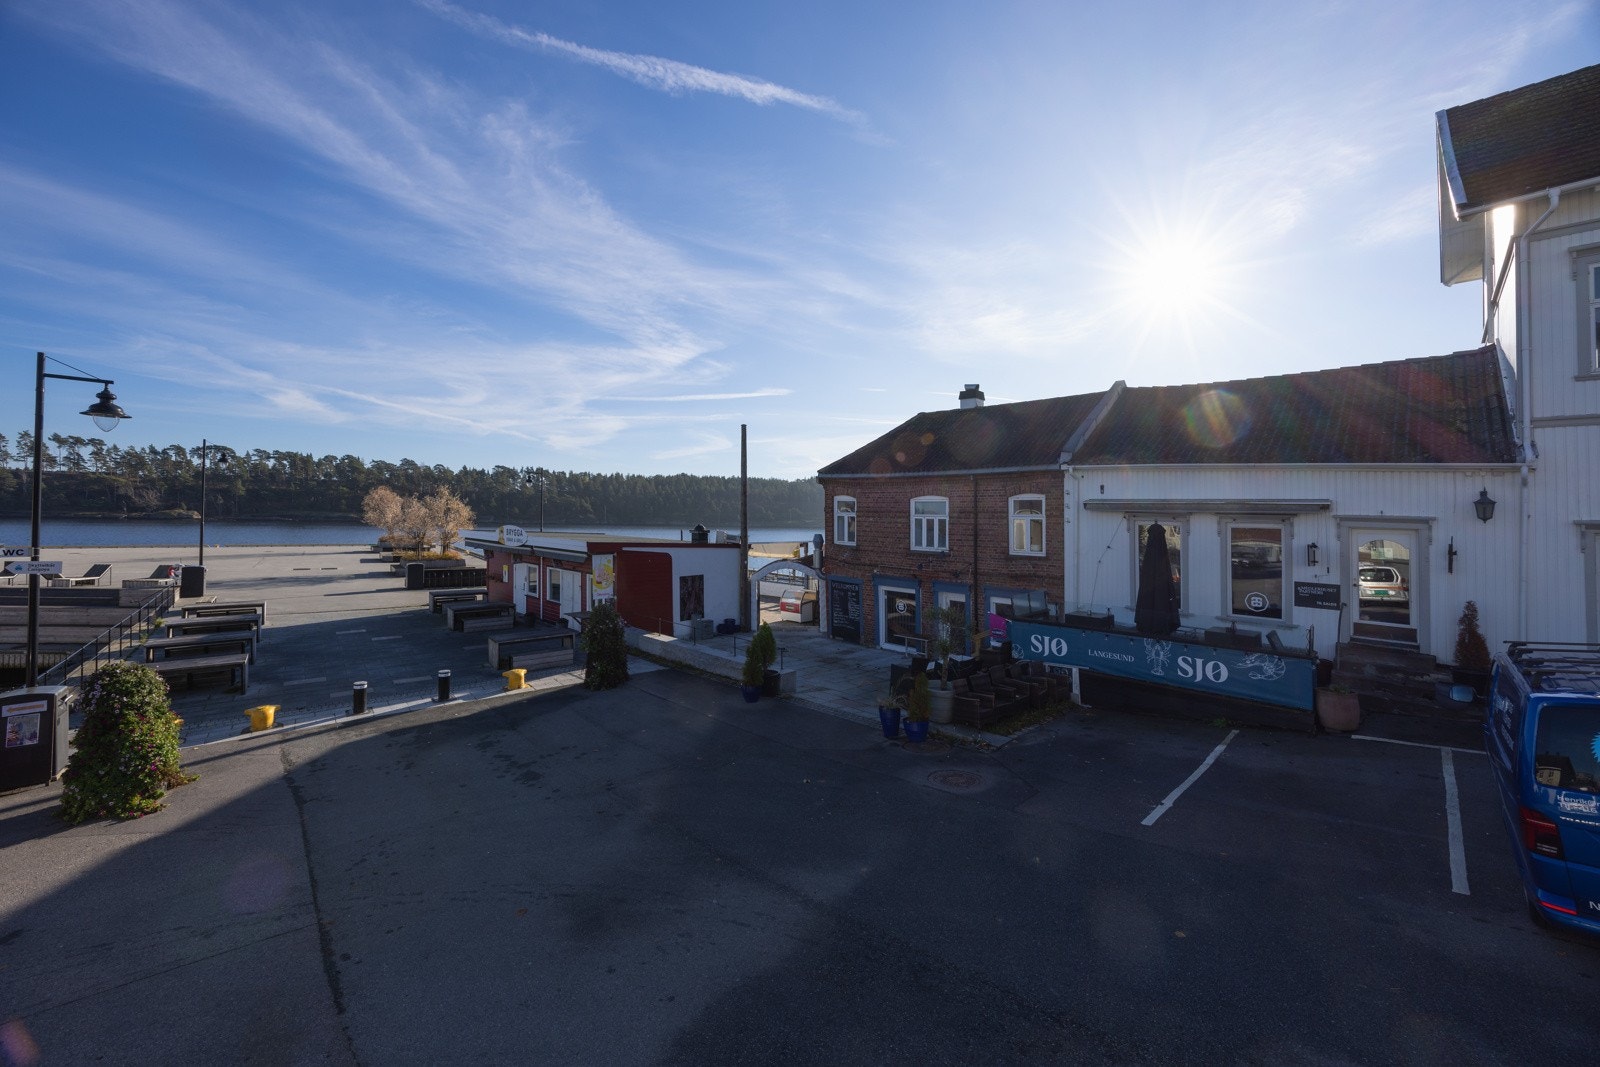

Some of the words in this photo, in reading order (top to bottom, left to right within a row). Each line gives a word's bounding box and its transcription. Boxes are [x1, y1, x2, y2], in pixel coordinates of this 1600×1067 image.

[506, 528, 523, 537] BRYGGA
[1030, 634, 1068, 657] SJØ
[1088, 648, 1135, 663] LANGESUND
[1177, 656, 1229, 683] SJØ
